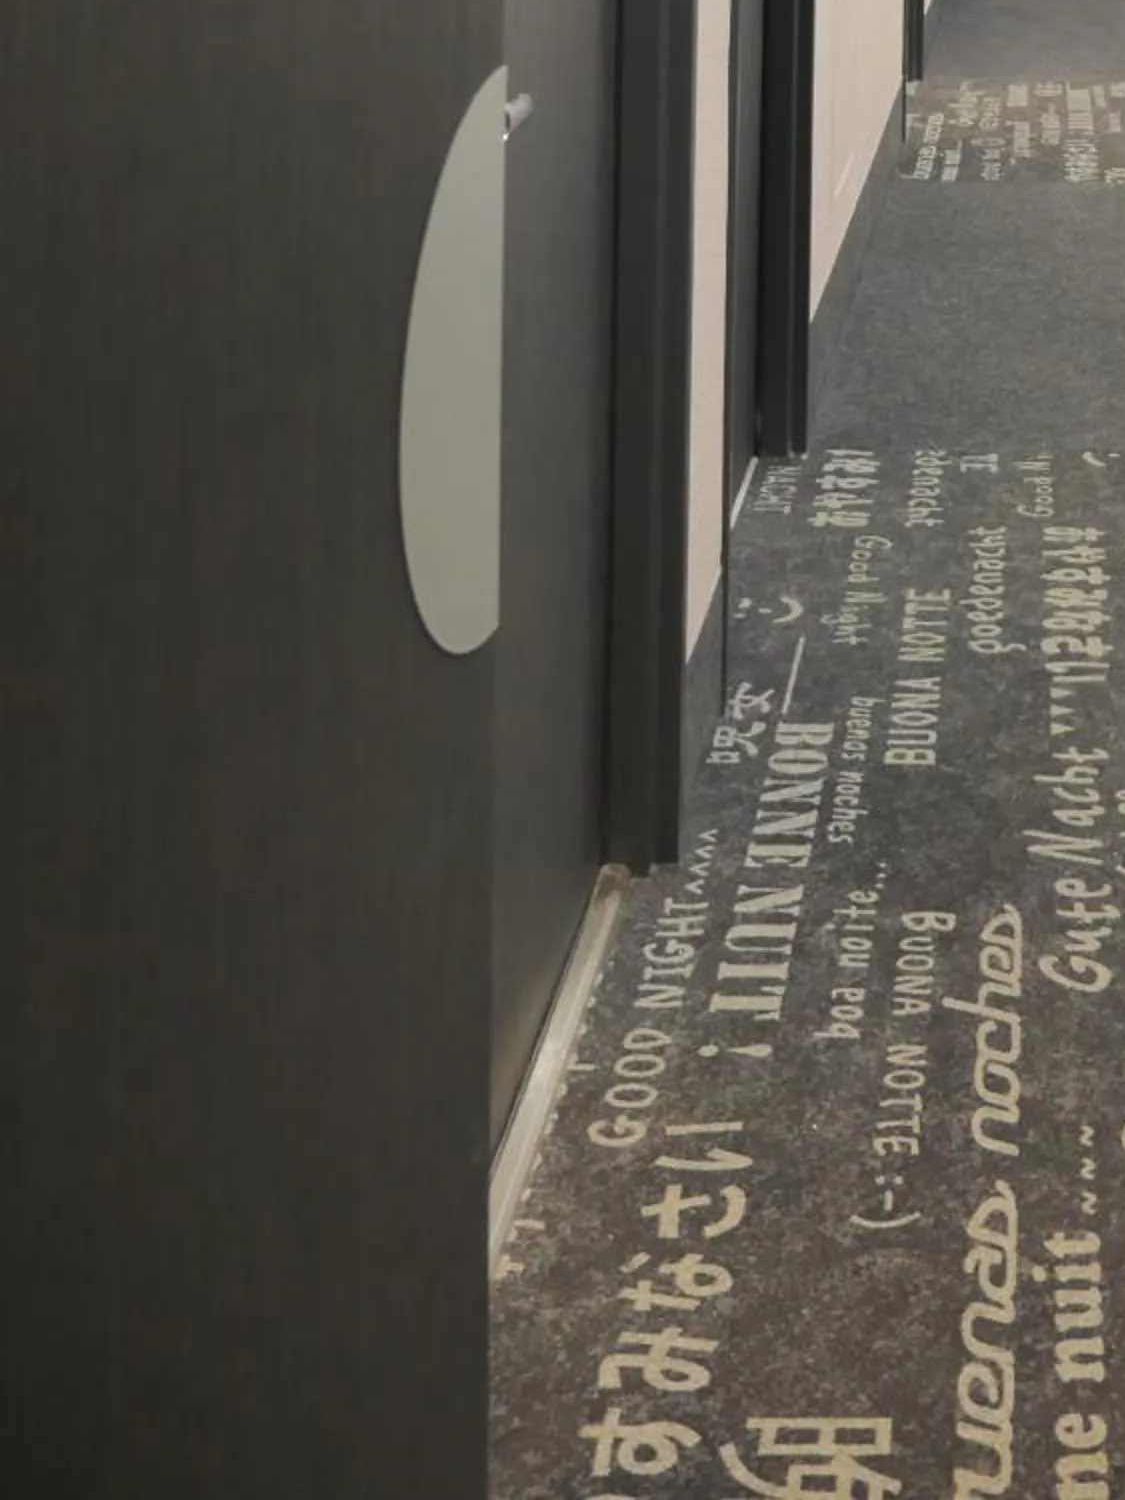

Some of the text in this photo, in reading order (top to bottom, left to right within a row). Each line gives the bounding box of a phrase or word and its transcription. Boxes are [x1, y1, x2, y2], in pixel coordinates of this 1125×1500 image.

[846, 535, 893, 583] Good
[959, 526, 1026, 654] goedenacht
[884, 588, 951, 765] BUONA NOTTE
[743, 722, 835, 868] BONNE
[827, 697, 885, 843] buenas noches
[1023, 746, 1121, 992] Gute Nacht
[708, 884, 804, 1020] NUIT
[813, 987, 866, 1039] boa
[892, 912, 956, 1016] BUONA
[587, 1028, 674, 1147] GOOD
[873, 1043, 927, 1156] NOTTE
[941, 903, 1024, 1500] uenas noches
[580, 1121, 753, 1500] すみなさい
[1029, 1231, 1105, 1382] nuit
